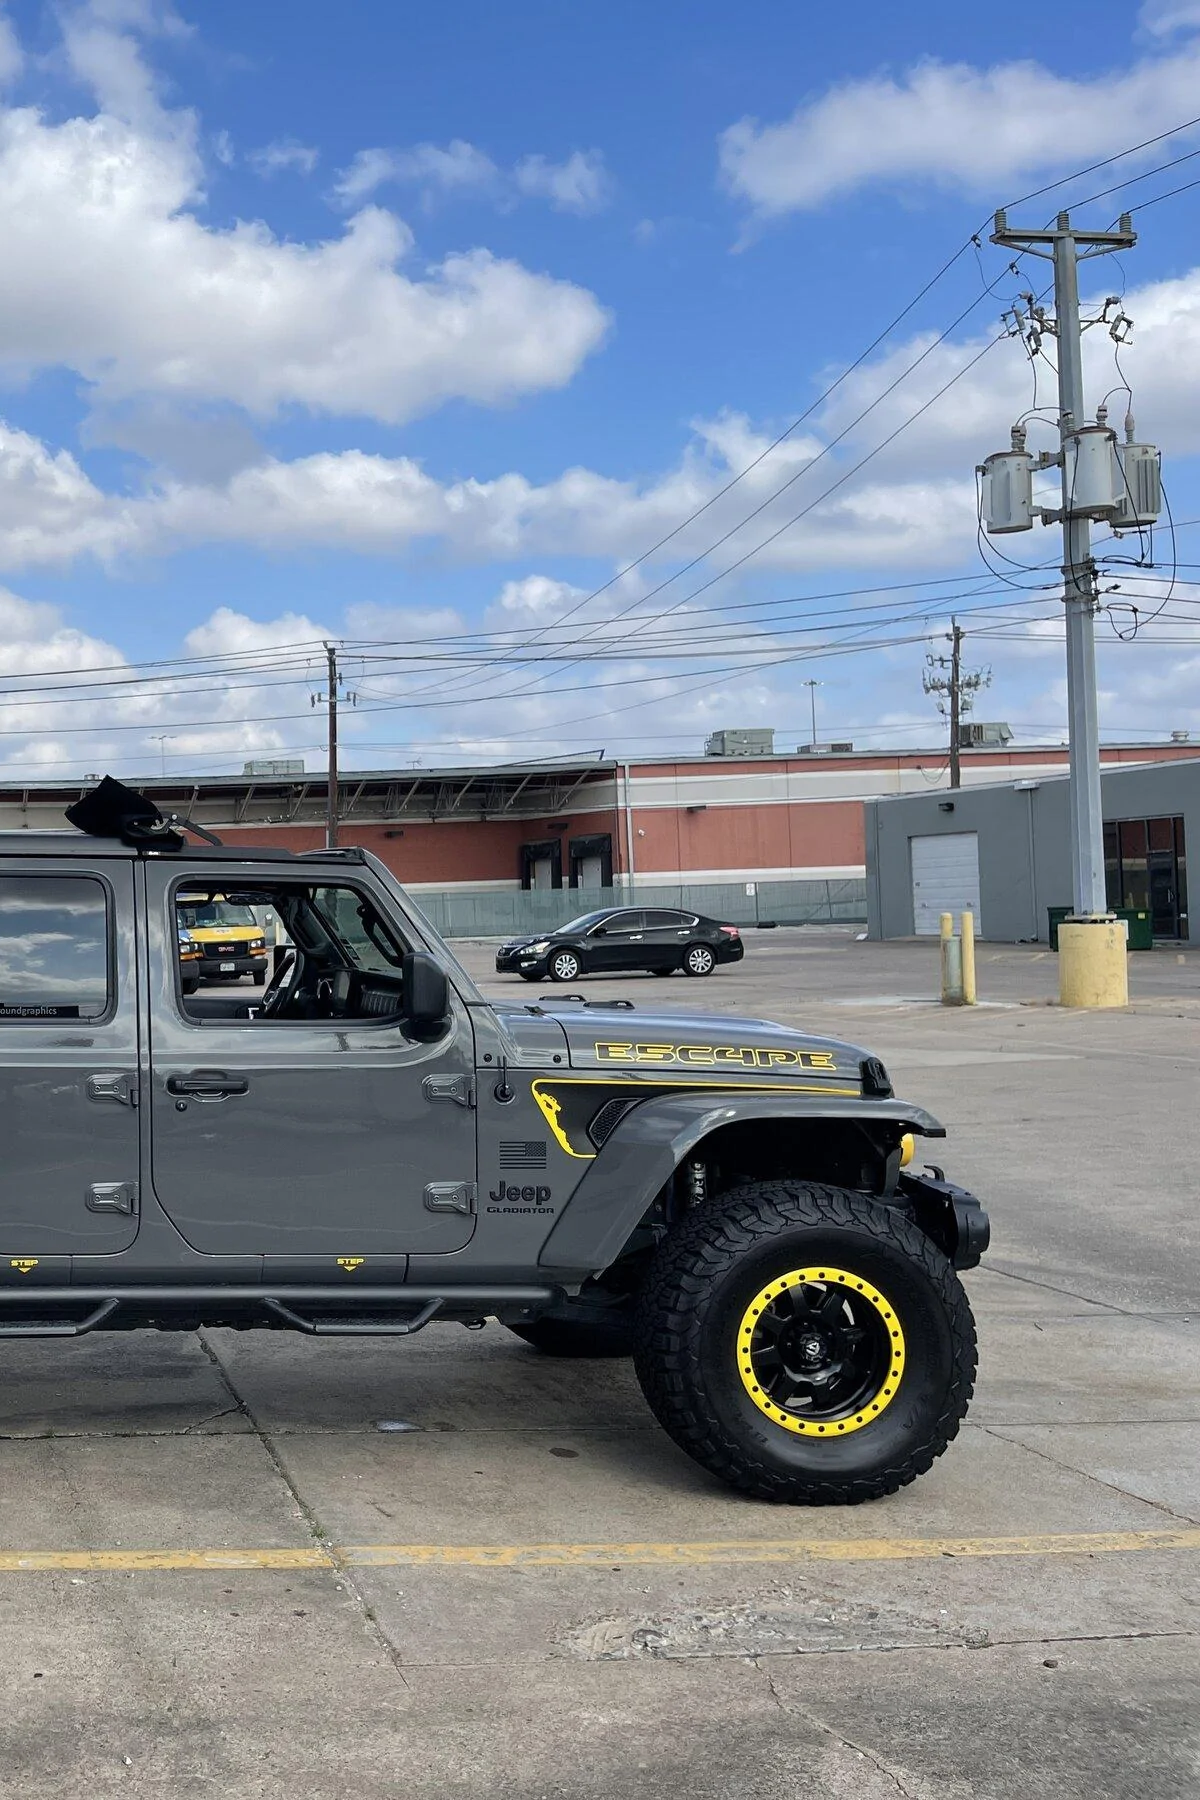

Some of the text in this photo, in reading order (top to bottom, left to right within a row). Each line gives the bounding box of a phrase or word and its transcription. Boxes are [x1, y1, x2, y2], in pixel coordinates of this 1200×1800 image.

[489, 1180, 552, 1206] Jeep
[486, 1206, 555, 1214] GLADIATOR
[10, 1259, 39, 1267] STEP
